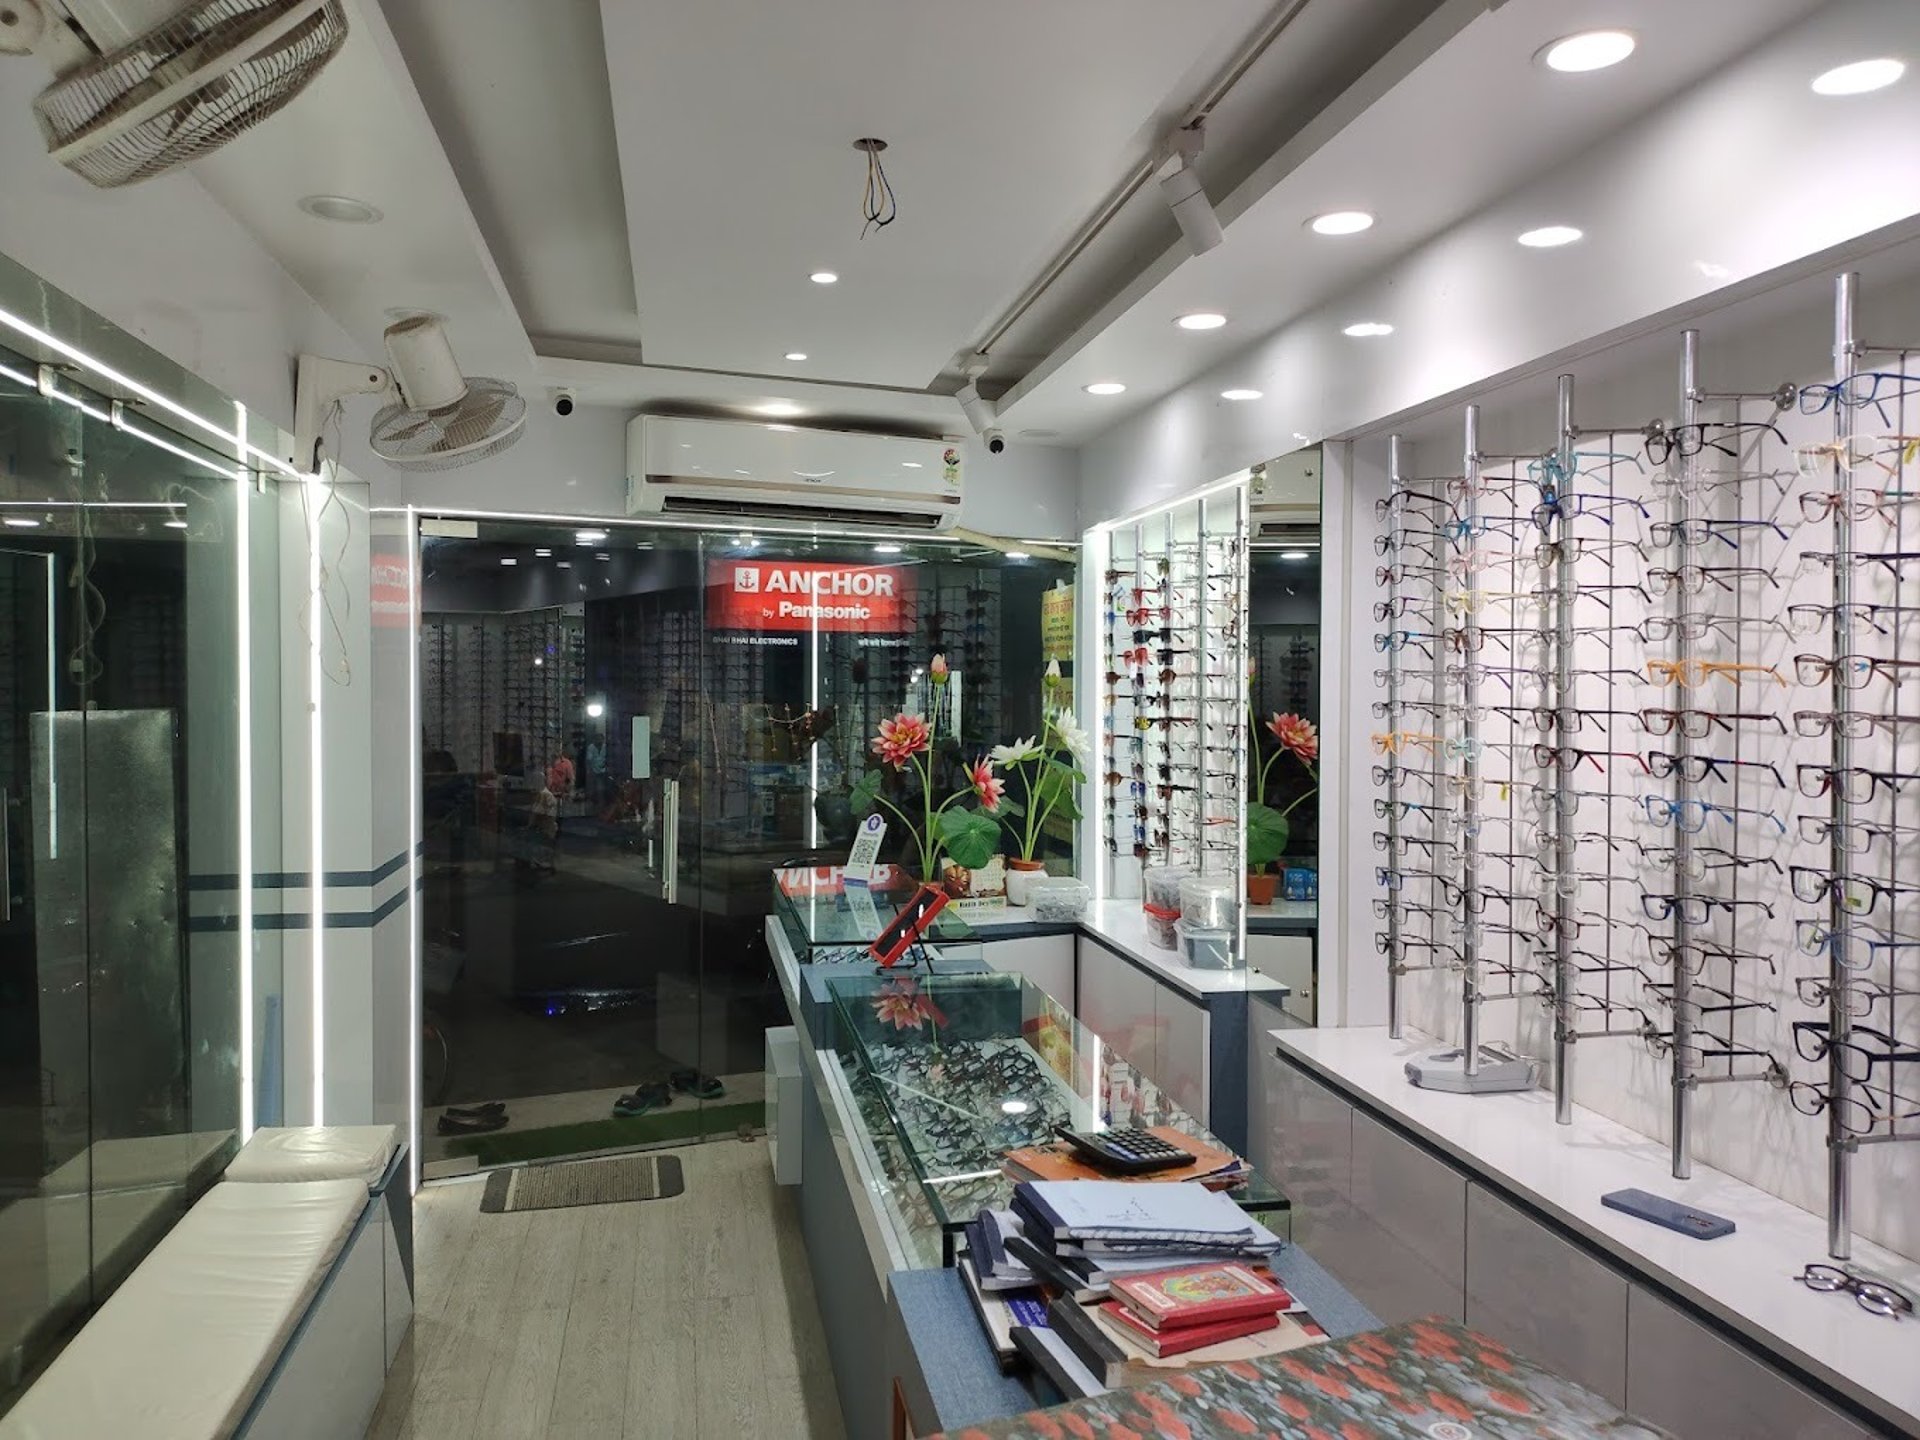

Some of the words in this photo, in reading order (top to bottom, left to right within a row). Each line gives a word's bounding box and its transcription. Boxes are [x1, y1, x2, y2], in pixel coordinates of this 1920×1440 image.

[764, 570, 894, 597] ANCHOR
[762, 607, 775, 619] by
[778, 600, 871, 619] Panasonic
[749, 637, 799, 646] ELECTRONICS
